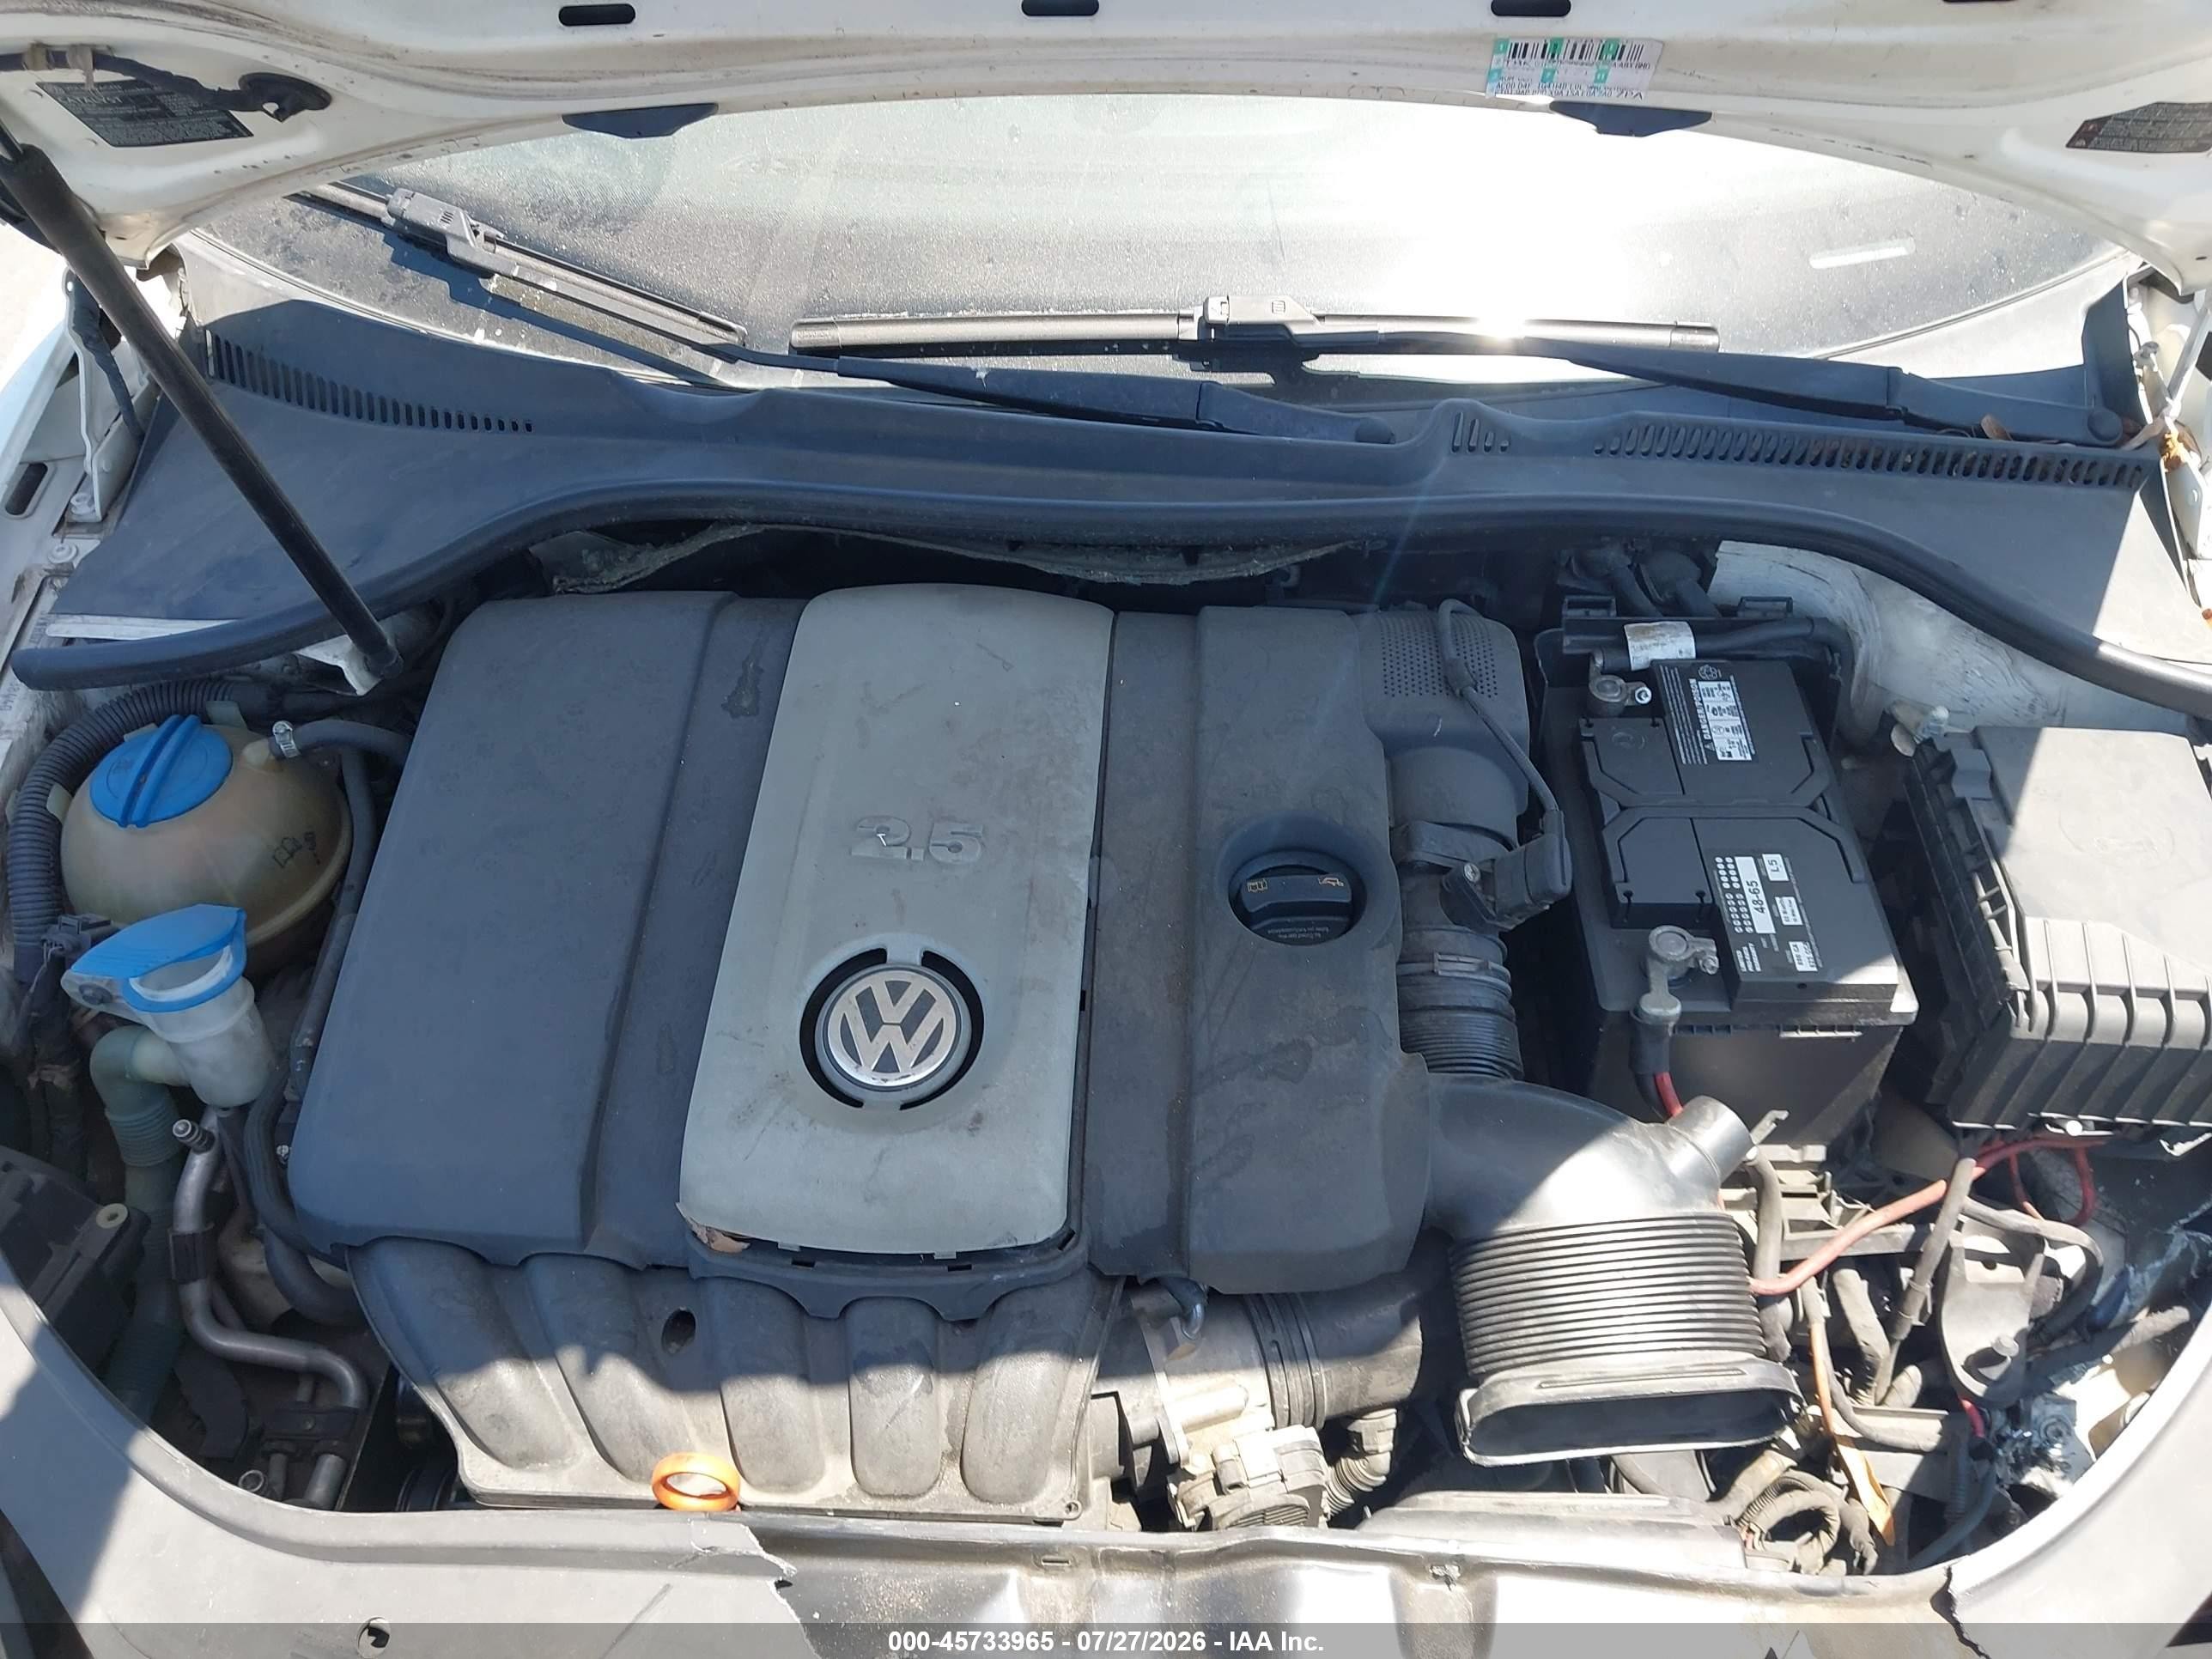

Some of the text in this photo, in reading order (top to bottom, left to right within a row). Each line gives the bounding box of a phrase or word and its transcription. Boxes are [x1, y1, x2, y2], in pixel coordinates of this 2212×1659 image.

[1689, 678, 1711, 740] DANGER/POISON
[850, 816, 984, 864] 2.5
[1747, 880, 1766, 915] 48-65
